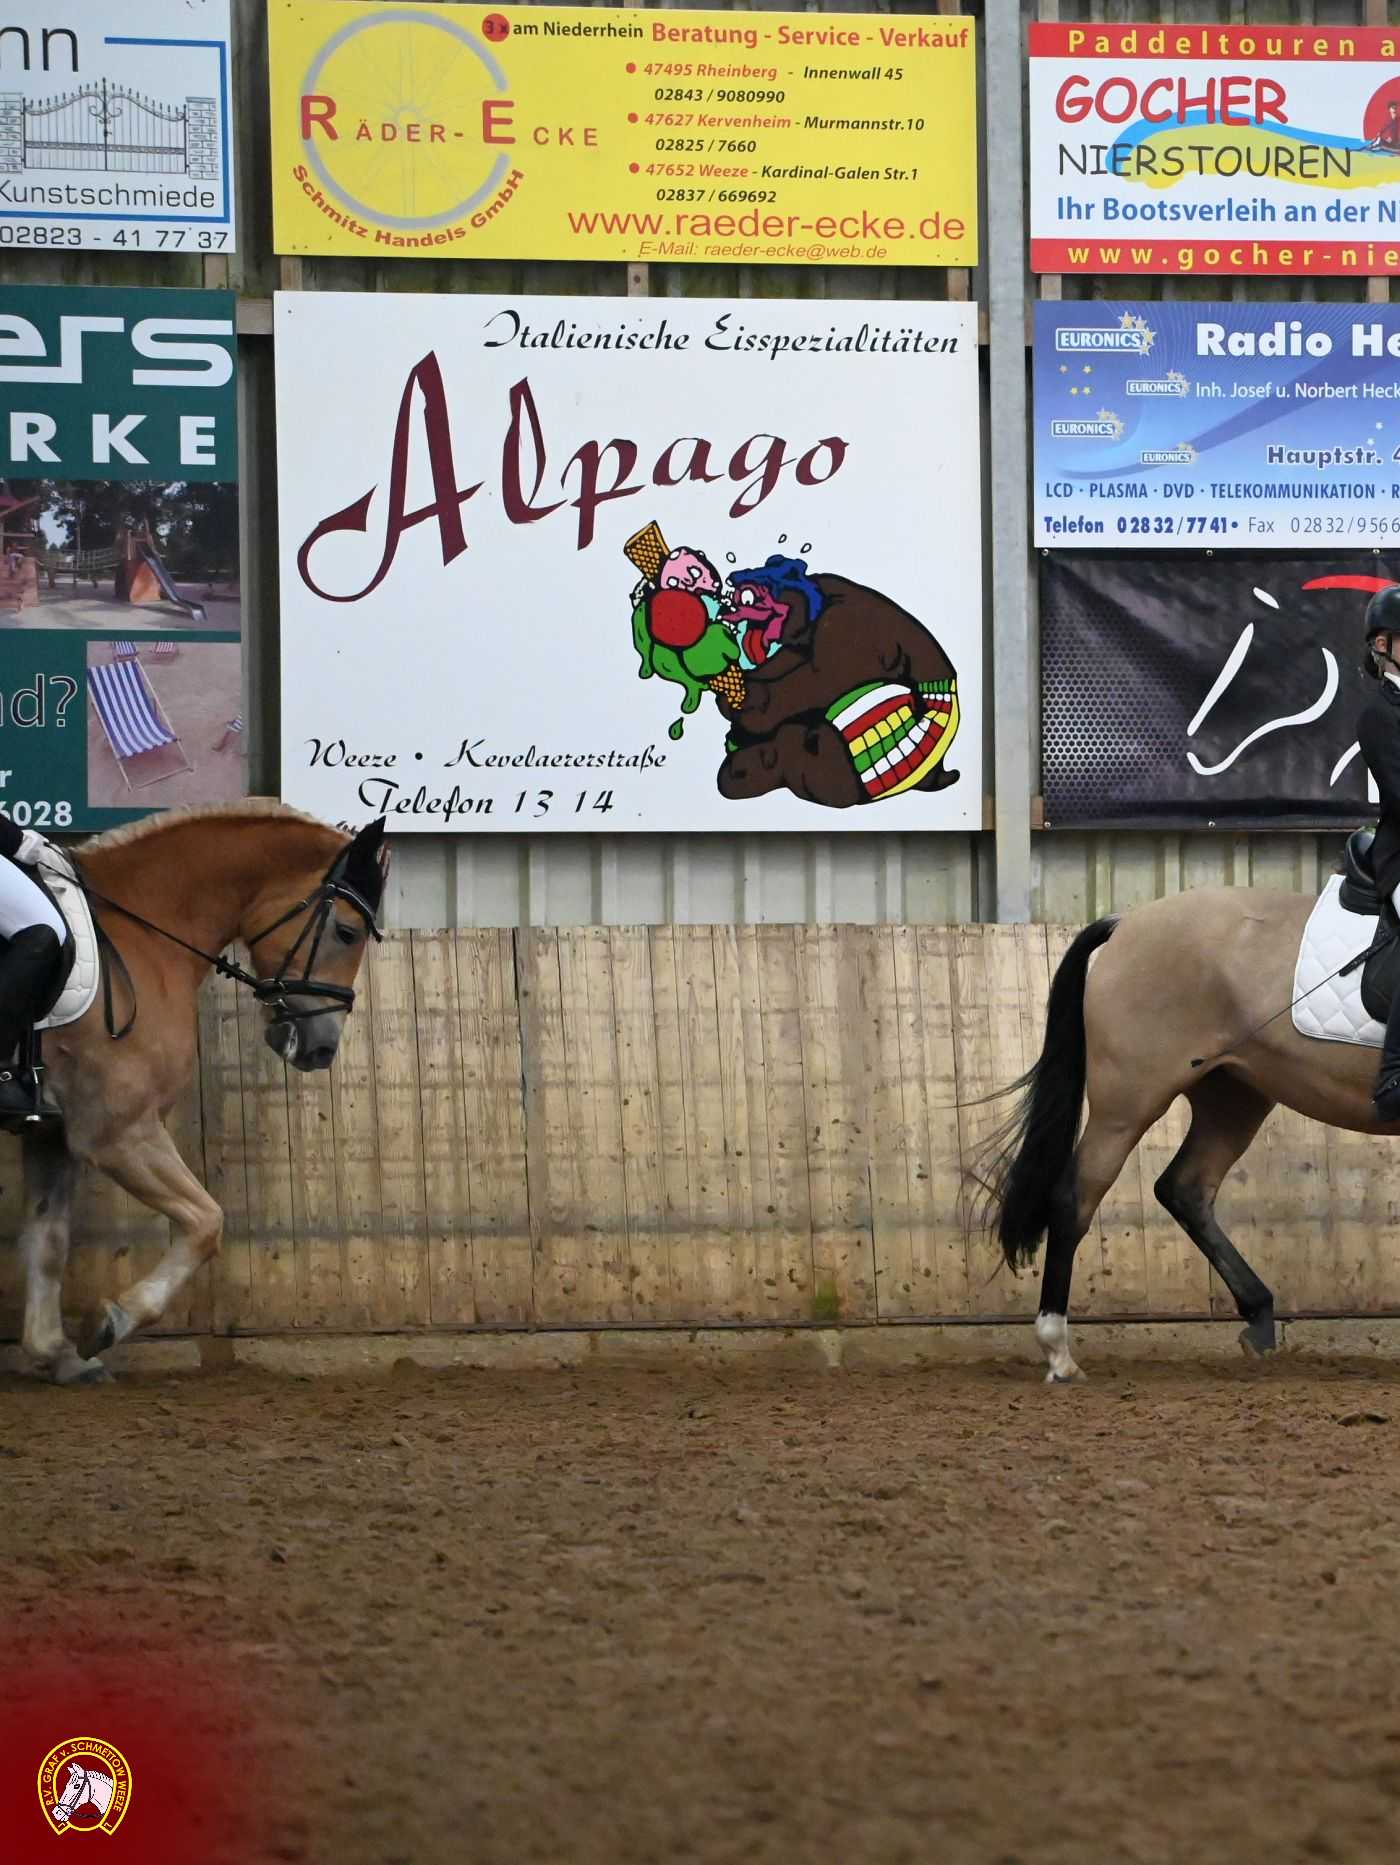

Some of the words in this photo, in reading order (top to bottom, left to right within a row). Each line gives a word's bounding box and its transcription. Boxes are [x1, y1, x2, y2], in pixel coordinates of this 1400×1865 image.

[513, 24, 538, 36] am
[543, 21, 643, 39] Niederrhein
[651, 22, 758, 48] Beratung
[778, 25, 860, 46] Service
[880, 27, 969, 49] Verkauf
[1068, 29, 1356, 56] Paddeltouren
[644, 63, 692, 77] 47495
[697, 62, 778, 81] Rheinberg
[803, 66, 880, 81] Innenwall
[884, 68, 904, 81] 45
[1055, 75, 1289, 126] GOCHER
[645, 113, 693, 127] 47627
[698, 113, 791, 129] Kervenheim
[646, 163, 694, 178] 47652
[699, 164, 749, 179] Weeze
[761, 165, 880, 181] Kardinal-Galen
[1058, 143, 1351, 179] NIERSTOUREN
[0, 180, 215, 208] Kunstschmiede
[293, 164, 368, 238] Schmitz
[375, 226, 466, 248] Handels
[470, 168, 525, 229] GmbH
[1057, 197, 1095, 220] Ihr
[1103, 197, 1276, 222] Bootsverleih
[1284, 203, 1316, 222] an
[1325, 199, 1369, 223] der
[0, 226, 82, 245] 02823
[113, 230, 140, 246] 41
[156, 230, 186, 248] 77
[198, 231, 228, 249] 37
[568, 208, 966, 241] www.raeder-ecke.de
[639, 241, 699, 258] E-Mail:
[704, 243, 887, 261] raeder-ecke@web.de
[483, 309, 690, 352] Italienische
[704, 313, 960, 360] Eisspezialitäten
[1060, 331, 1142, 348] EURONICS
[1196, 321, 1333, 358] Radio
[1129, 381, 1182, 394] EURONICS
[1196, 383, 1226, 398] Inh.
[1230, 382, 1272, 399] Josef
[1276, 387, 1290, 398] u.
[1295, 382, 1359, 399] Norbert
[1054, 422, 1113, 435] EURONICS
[1143, 452, 1191, 463] EURONICS
[1266, 443, 1383, 470] Hauptstr.
[297, 350, 850, 603] Alpago
[1045, 483, 1074, 499] LCD
[1089, 483, 1149, 499] PLASMA
[1163, 483, 1195, 499] DVD
[1210, 483, 1376, 499] TELEKOMMUNIKATION
[1044, 516, 1105, 534] Telefon
[1248, 517, 1275, 533] Fax
[0, 673, 79, 728] d?
[304, 738, 397, 770] Weeze
[444, 738, 667, 774] Kevelaererstraße
[357, 777, 494, 823] Telefon
[514, 789, 554, 818] 13
[575, 789, 614, 815] 14
